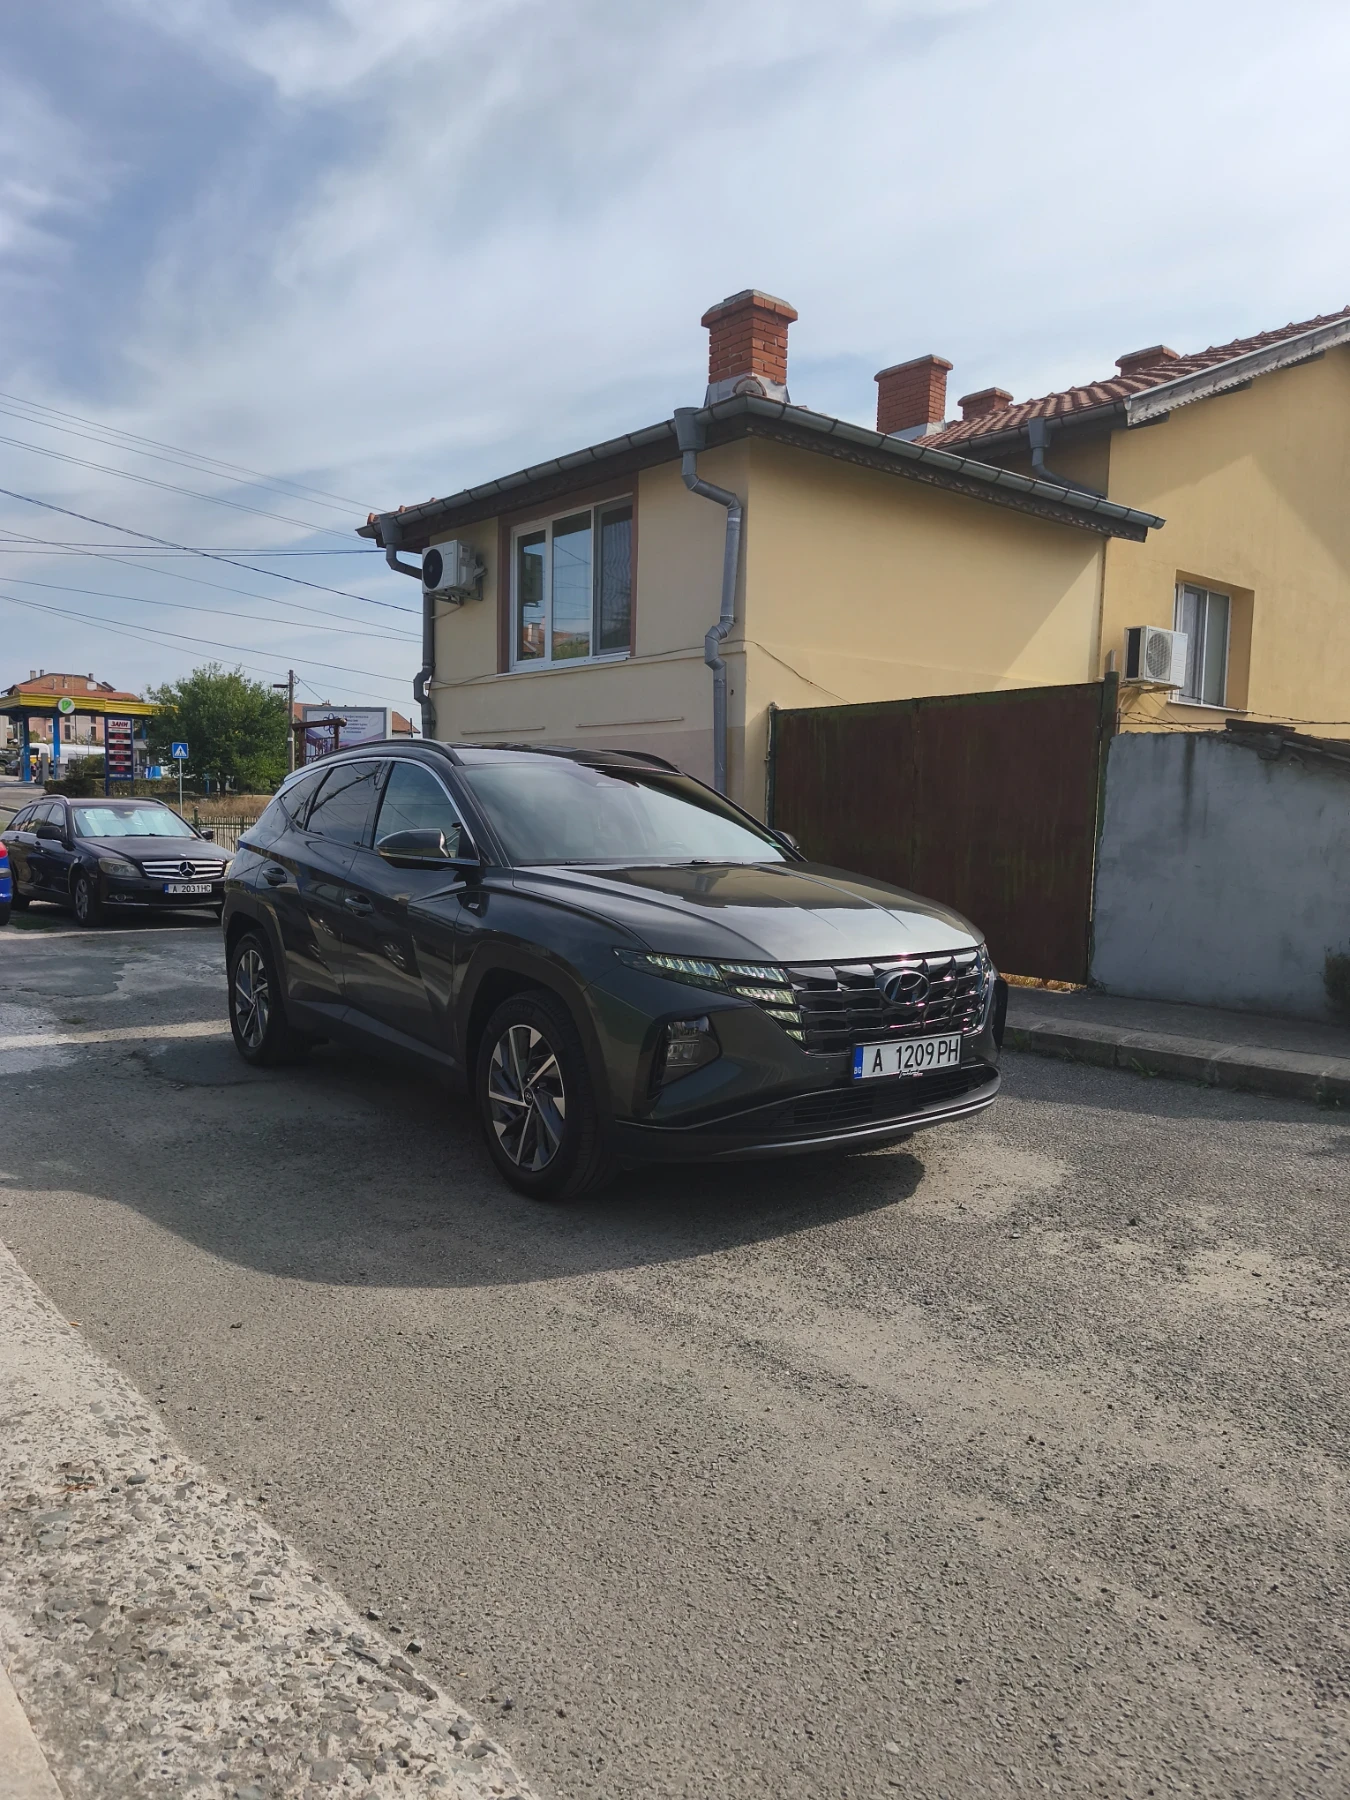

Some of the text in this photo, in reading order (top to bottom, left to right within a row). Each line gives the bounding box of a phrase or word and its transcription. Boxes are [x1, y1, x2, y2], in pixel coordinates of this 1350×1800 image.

[872, 1038, 959, 1073] A 1209PH
[853, 1066, 862, 1075] BG
